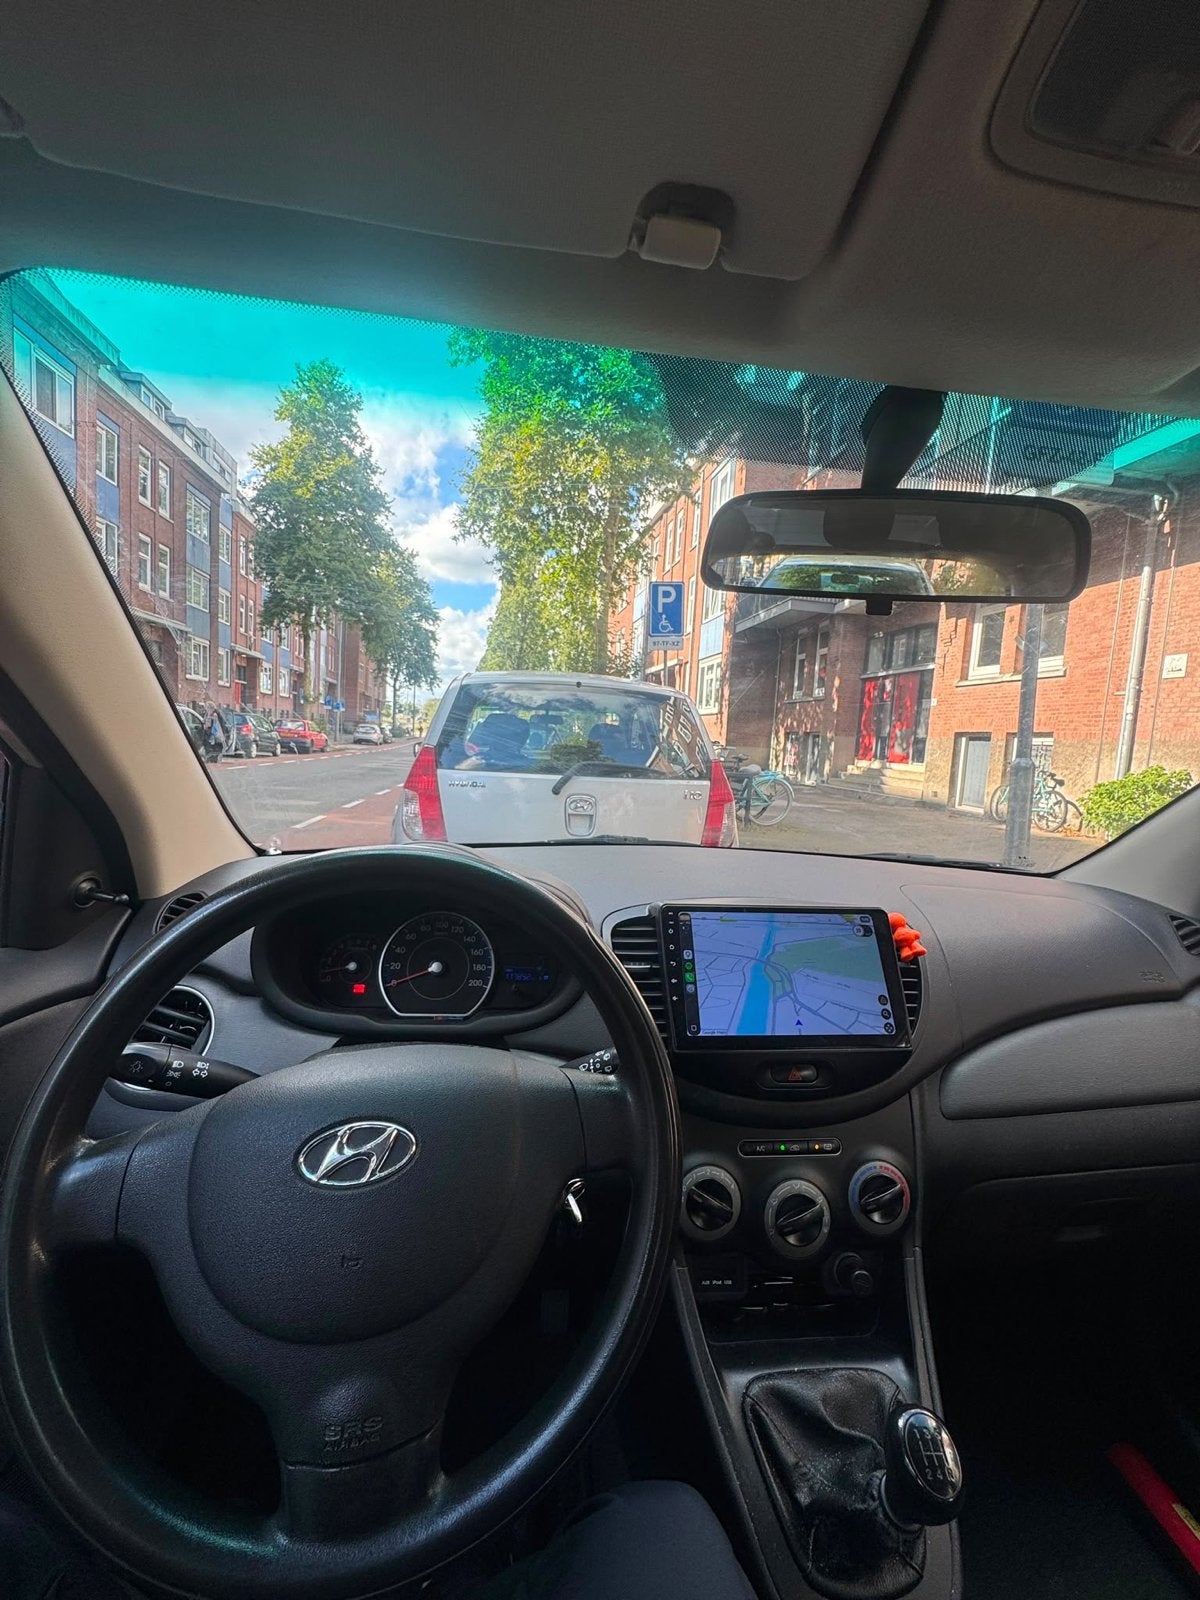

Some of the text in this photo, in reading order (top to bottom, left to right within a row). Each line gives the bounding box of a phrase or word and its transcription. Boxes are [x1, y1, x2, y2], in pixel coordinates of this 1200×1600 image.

[657, 586, 677, 613] P
[451, 926, 465, 934] 120
[406, 932, 417, 940] 60
[463, 935, 476, 943] 140
[394, 946, 406, 954] 40
[471, 948, 484, 956] 160
[390, 962, 401, 970] 20
[473, 963, 486, 971] 180
[468, 979, 483, 987] 200
[324, 1415, 385, 1441] SRS
[913, 1429, 920, 1439] 1
[922, 1428, 931, 1440] 3
[323, 1434, 382, 1452] AIRBAG
[926, 1468, 934, 1480] 2
[936, 1469, 943, 1480] 4
